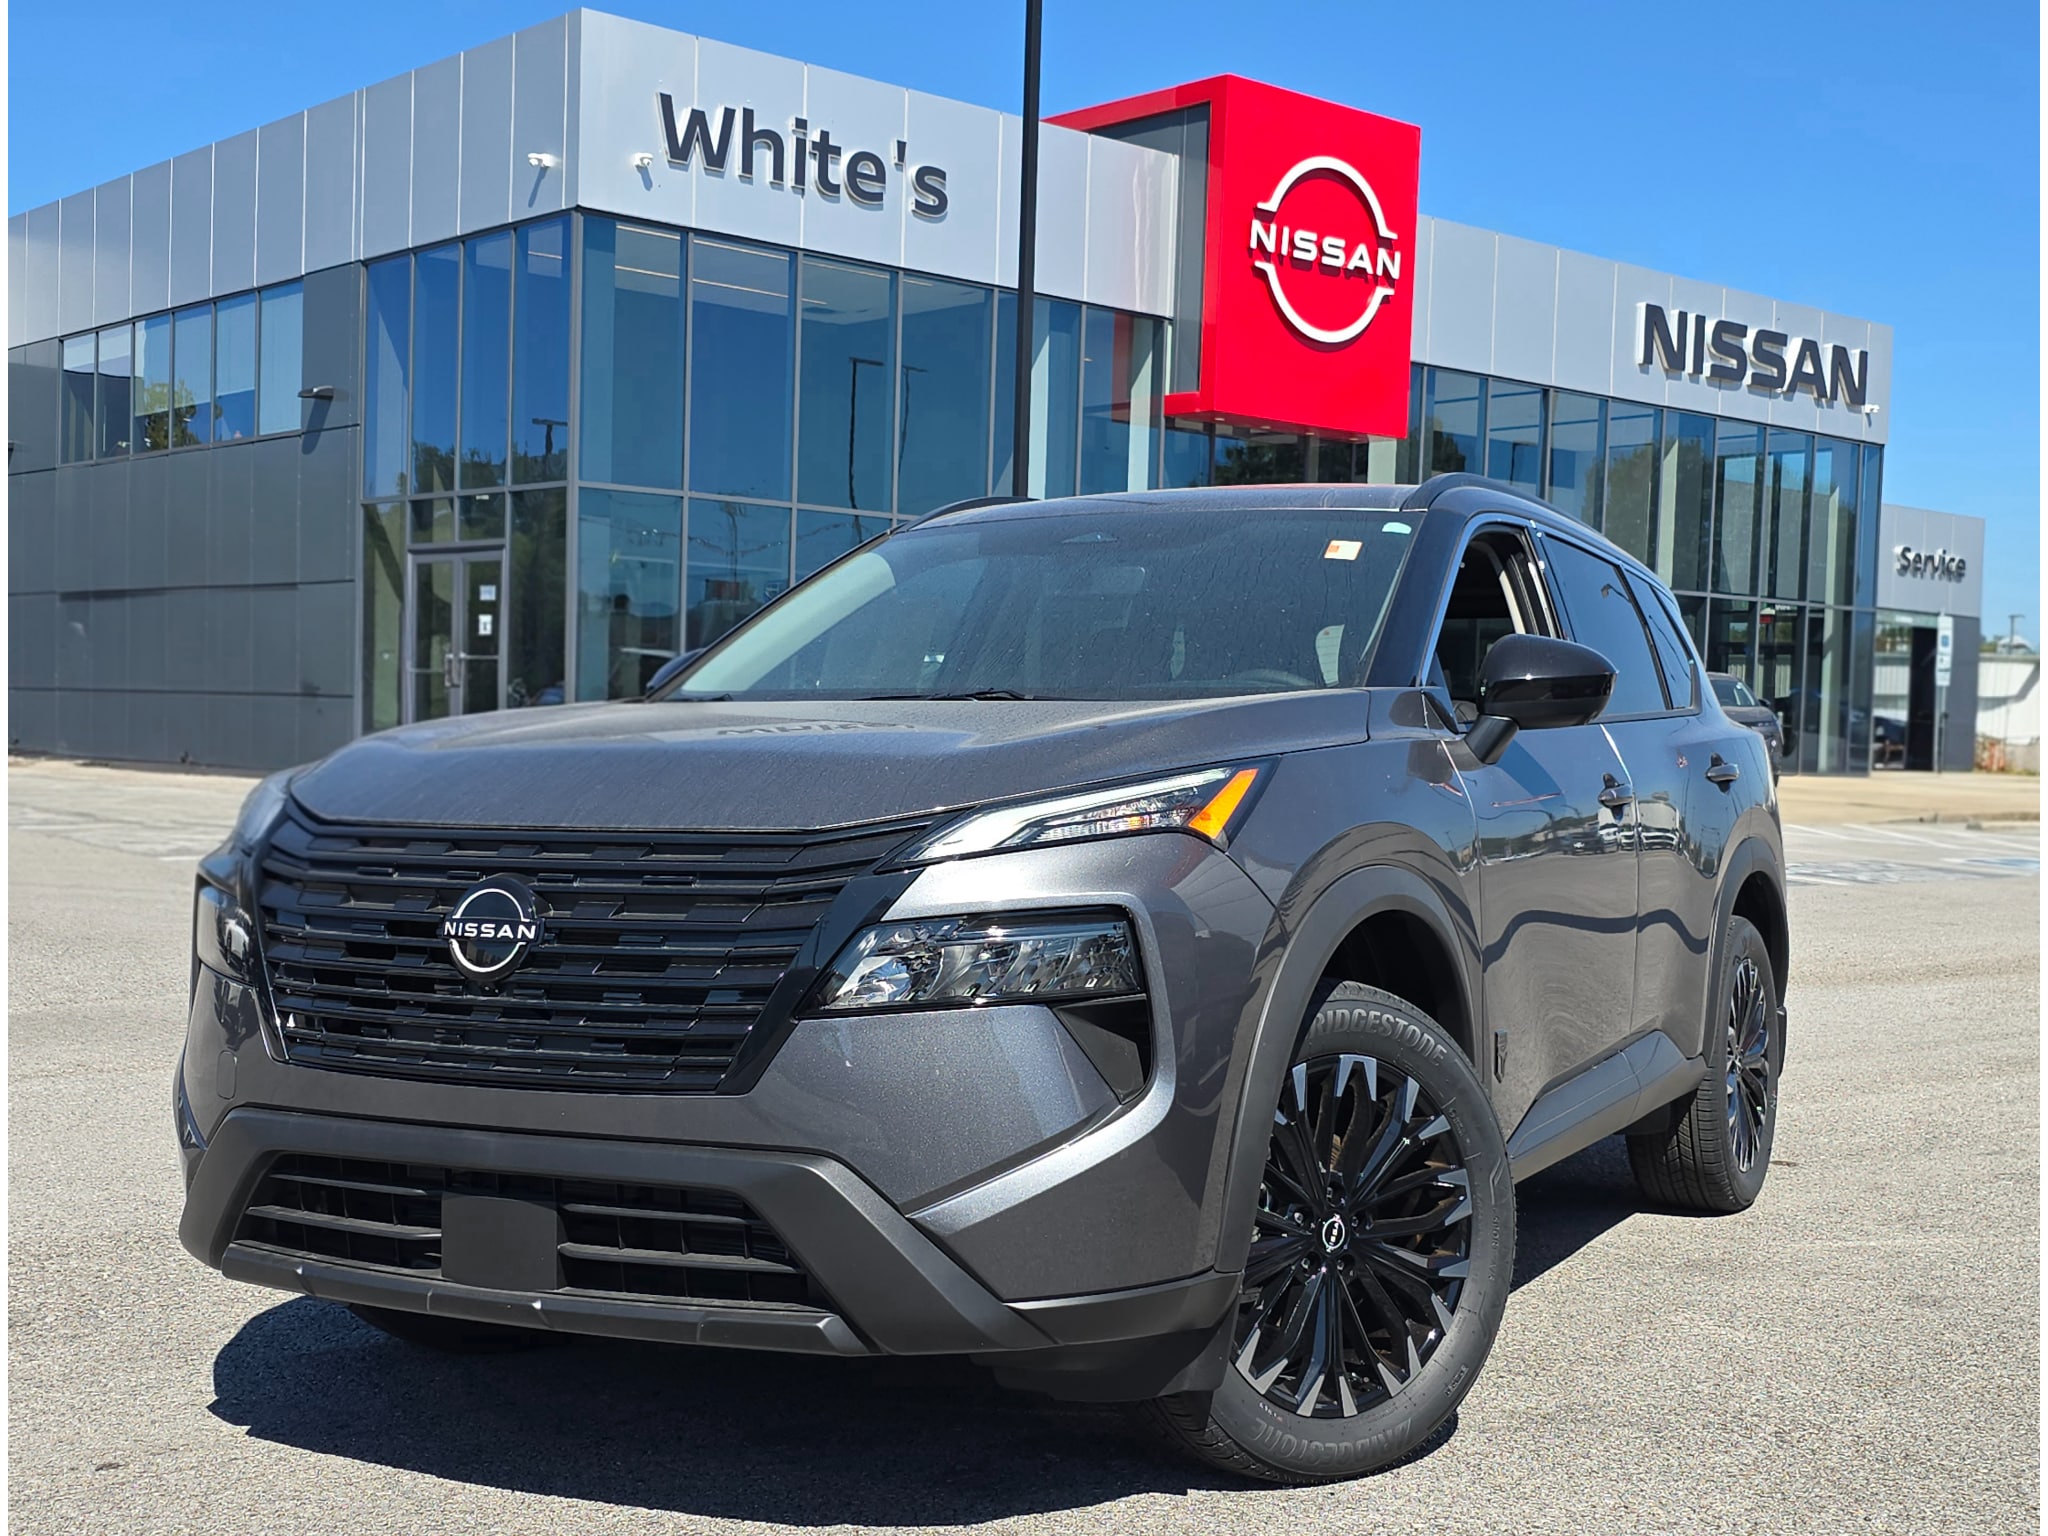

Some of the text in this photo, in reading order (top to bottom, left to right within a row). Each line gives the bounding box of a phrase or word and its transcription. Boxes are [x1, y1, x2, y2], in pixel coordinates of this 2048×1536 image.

[656, 92, 948, 217] White's
[1250, 219, 1400, 280] NISSAN
[1639, 302, 1868, 406] NISSAN
[1898, 546, 1966, 579] Service
[444, 921, 536, 939] NISSAN
[1309, 1008, 1448, 1067] RIDGESTONE
